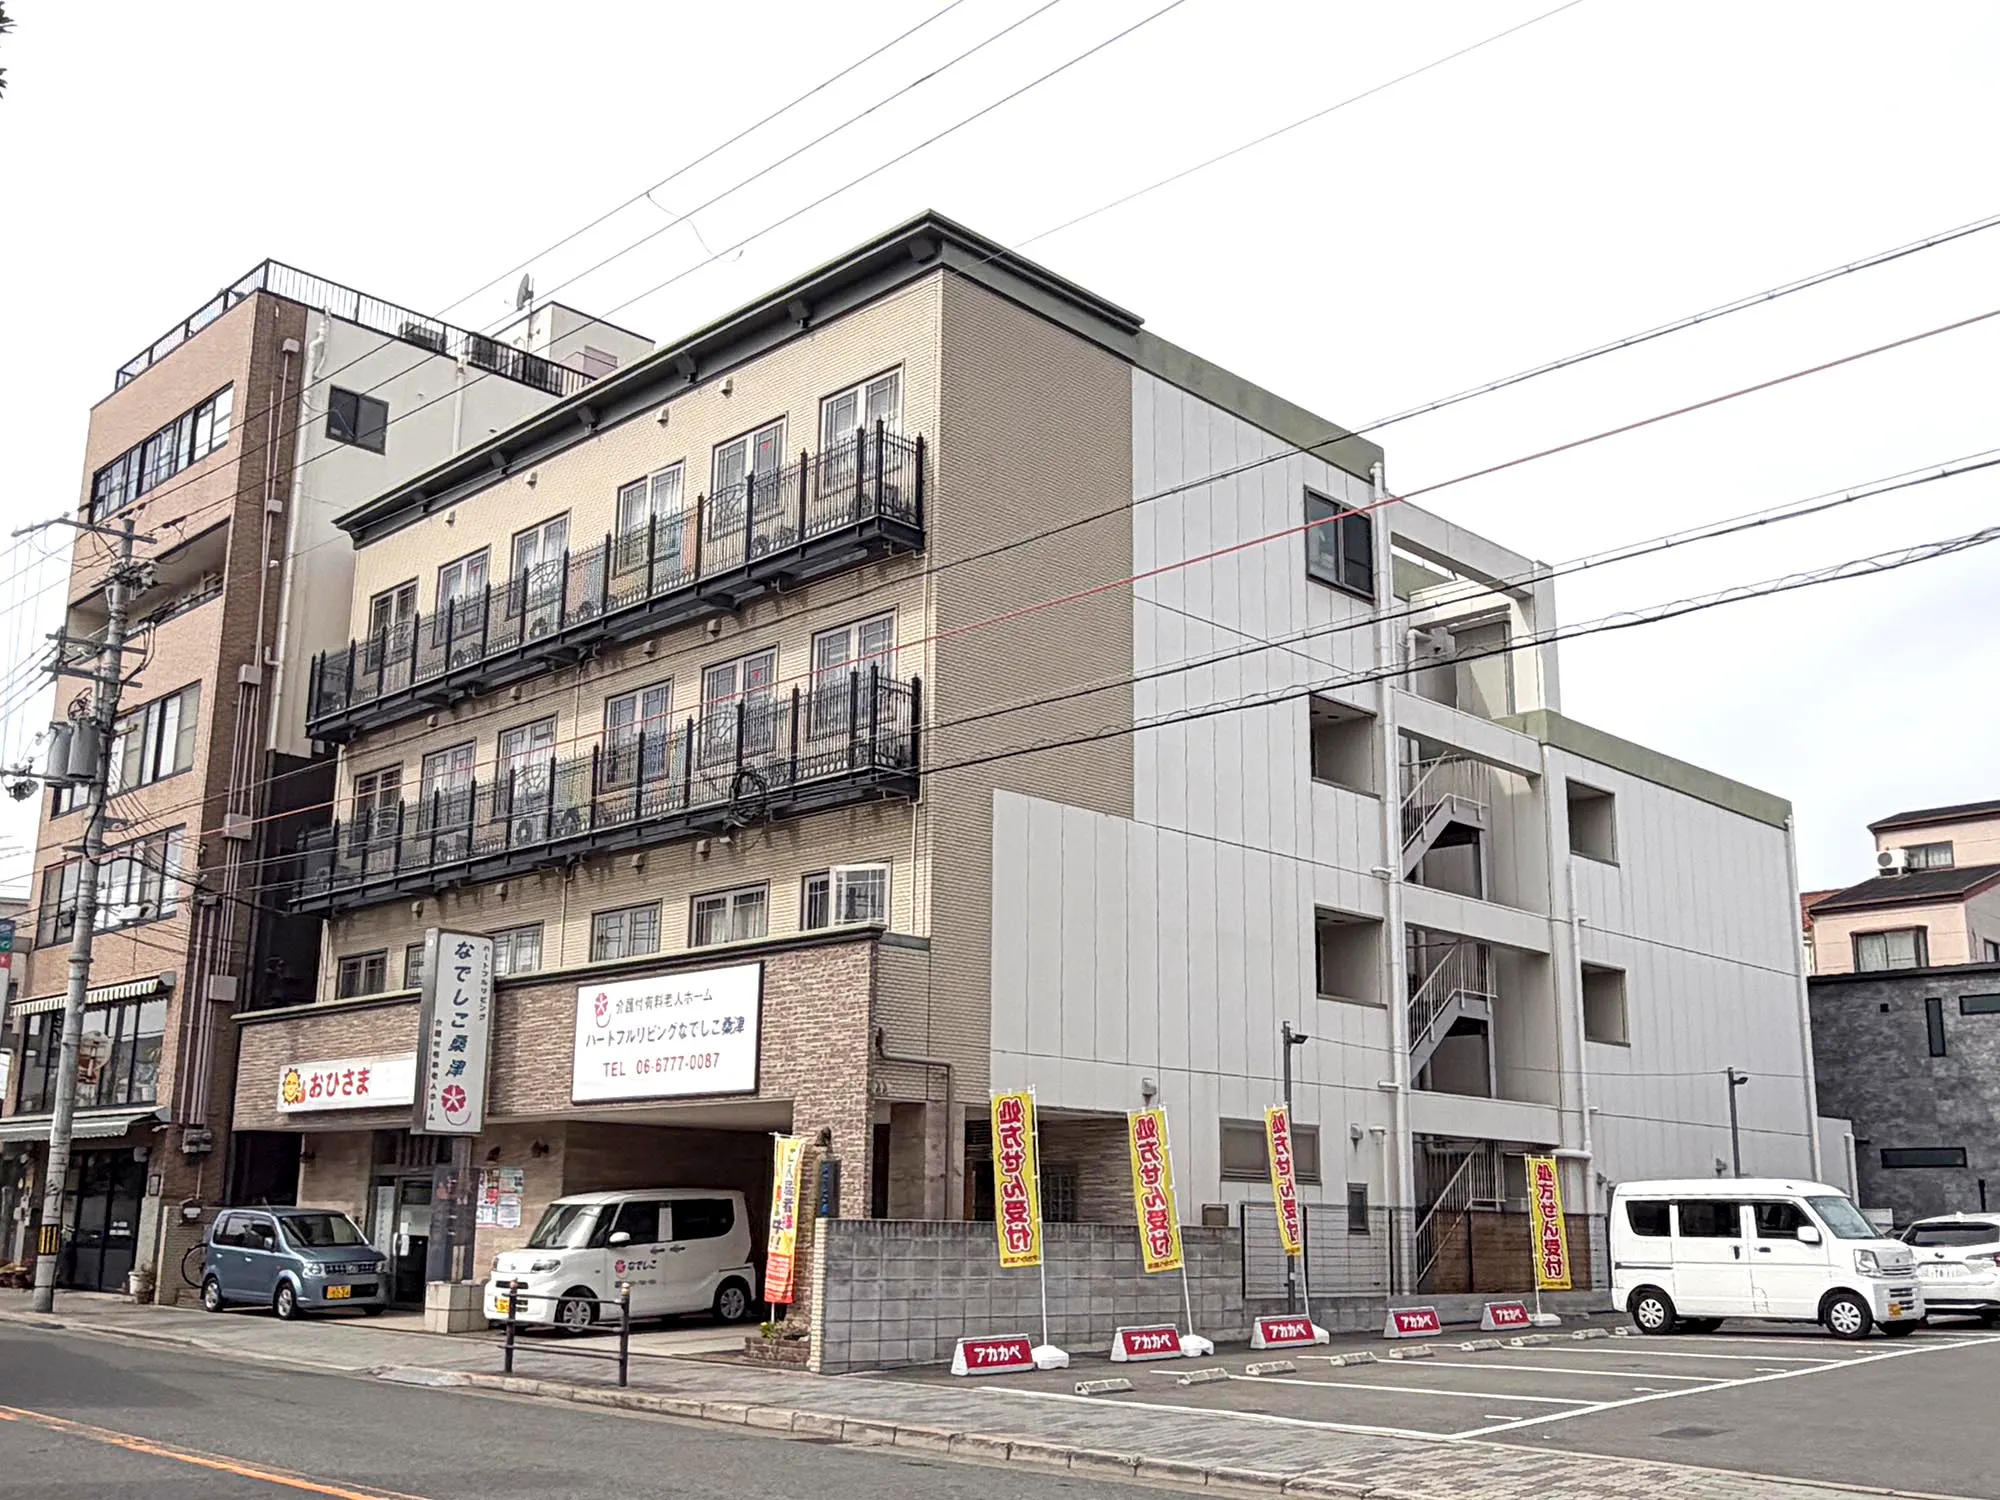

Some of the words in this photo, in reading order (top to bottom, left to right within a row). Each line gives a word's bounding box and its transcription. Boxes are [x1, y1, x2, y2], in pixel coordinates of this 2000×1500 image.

[445, 941, 475, 1077] なでしこ桑津
[616, 988, 713, 1014] 介護付有料老人ホーム
[586, 1016, 745, 1047] ハートフルリビングなでしこ桑津
[603, 1061, 626, 1077] TEL
[309, 1067, 370, 1098] おひさま
[1537, 1163, 1562, 1277] 処方せん受付
[1400, 1314, 1434, 1329] アカカベ
[1496, 1308, 1524, 1322] アカカベ
[1268, 1323, 1308, 1340] アカカベ
[1130, 1333, 1173, 1350] アカカベ
[973, 1346, 1023, 1364] アカカベ
